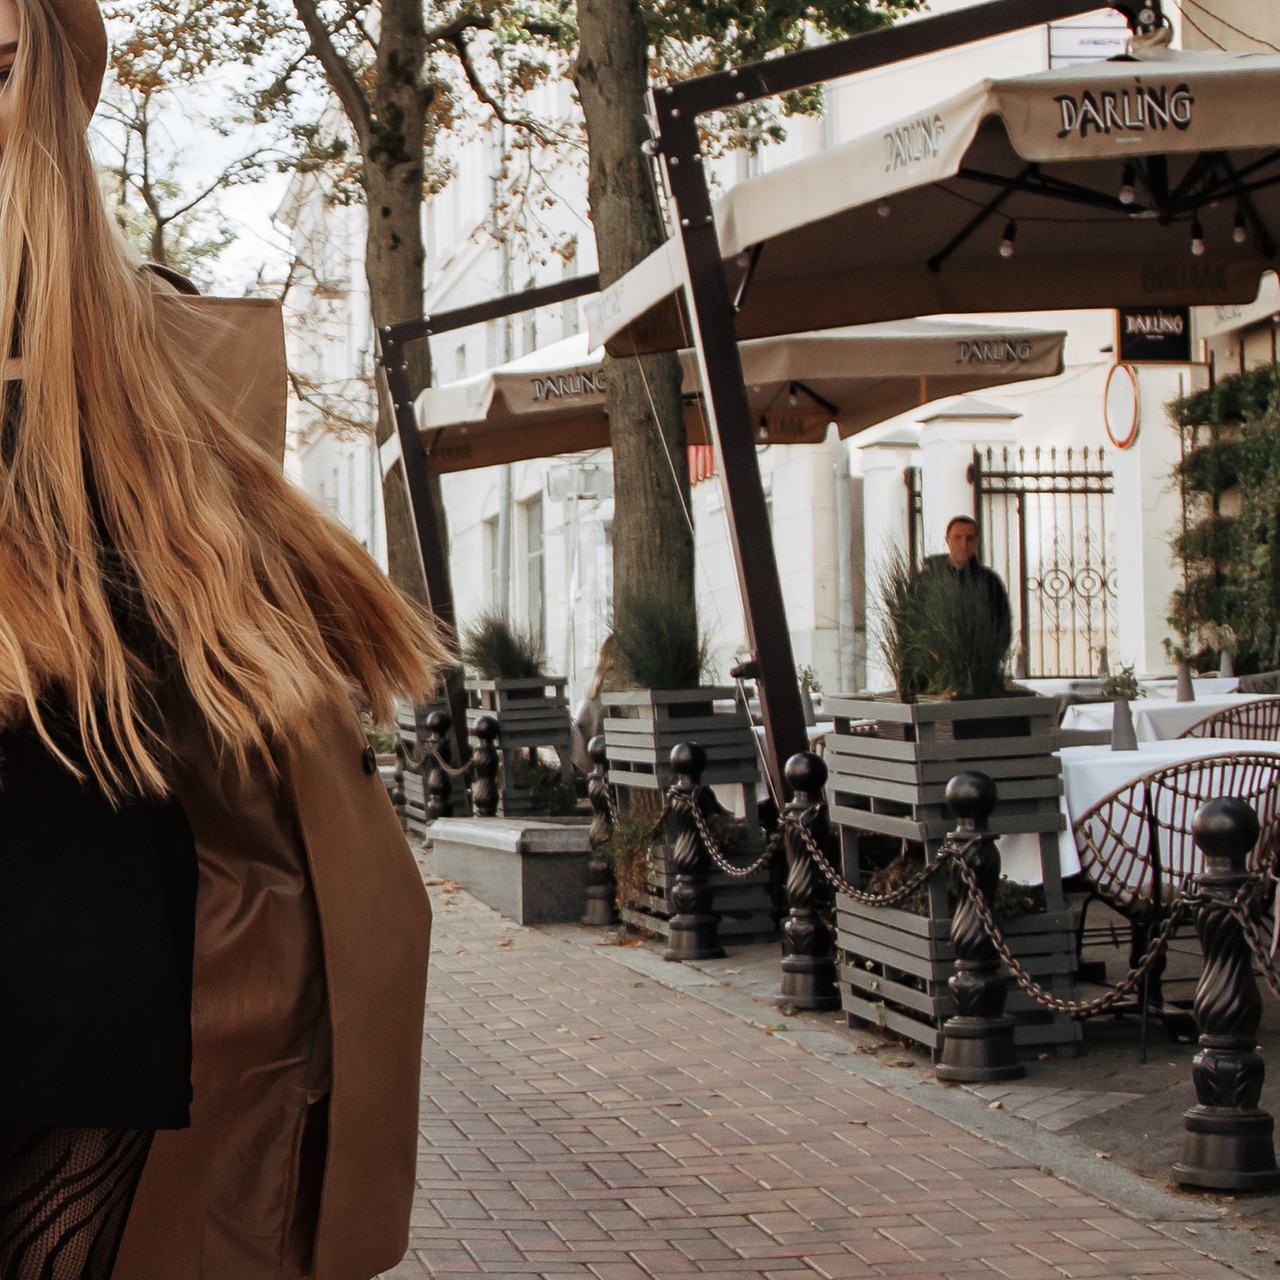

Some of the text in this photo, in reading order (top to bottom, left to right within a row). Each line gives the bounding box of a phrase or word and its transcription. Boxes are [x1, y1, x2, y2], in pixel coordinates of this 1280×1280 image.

[1053, 76, 1195, 138] DARLING
[1125, 309, 1183, 335] DARLING
[956, 335, 1032, 364] DARLING
